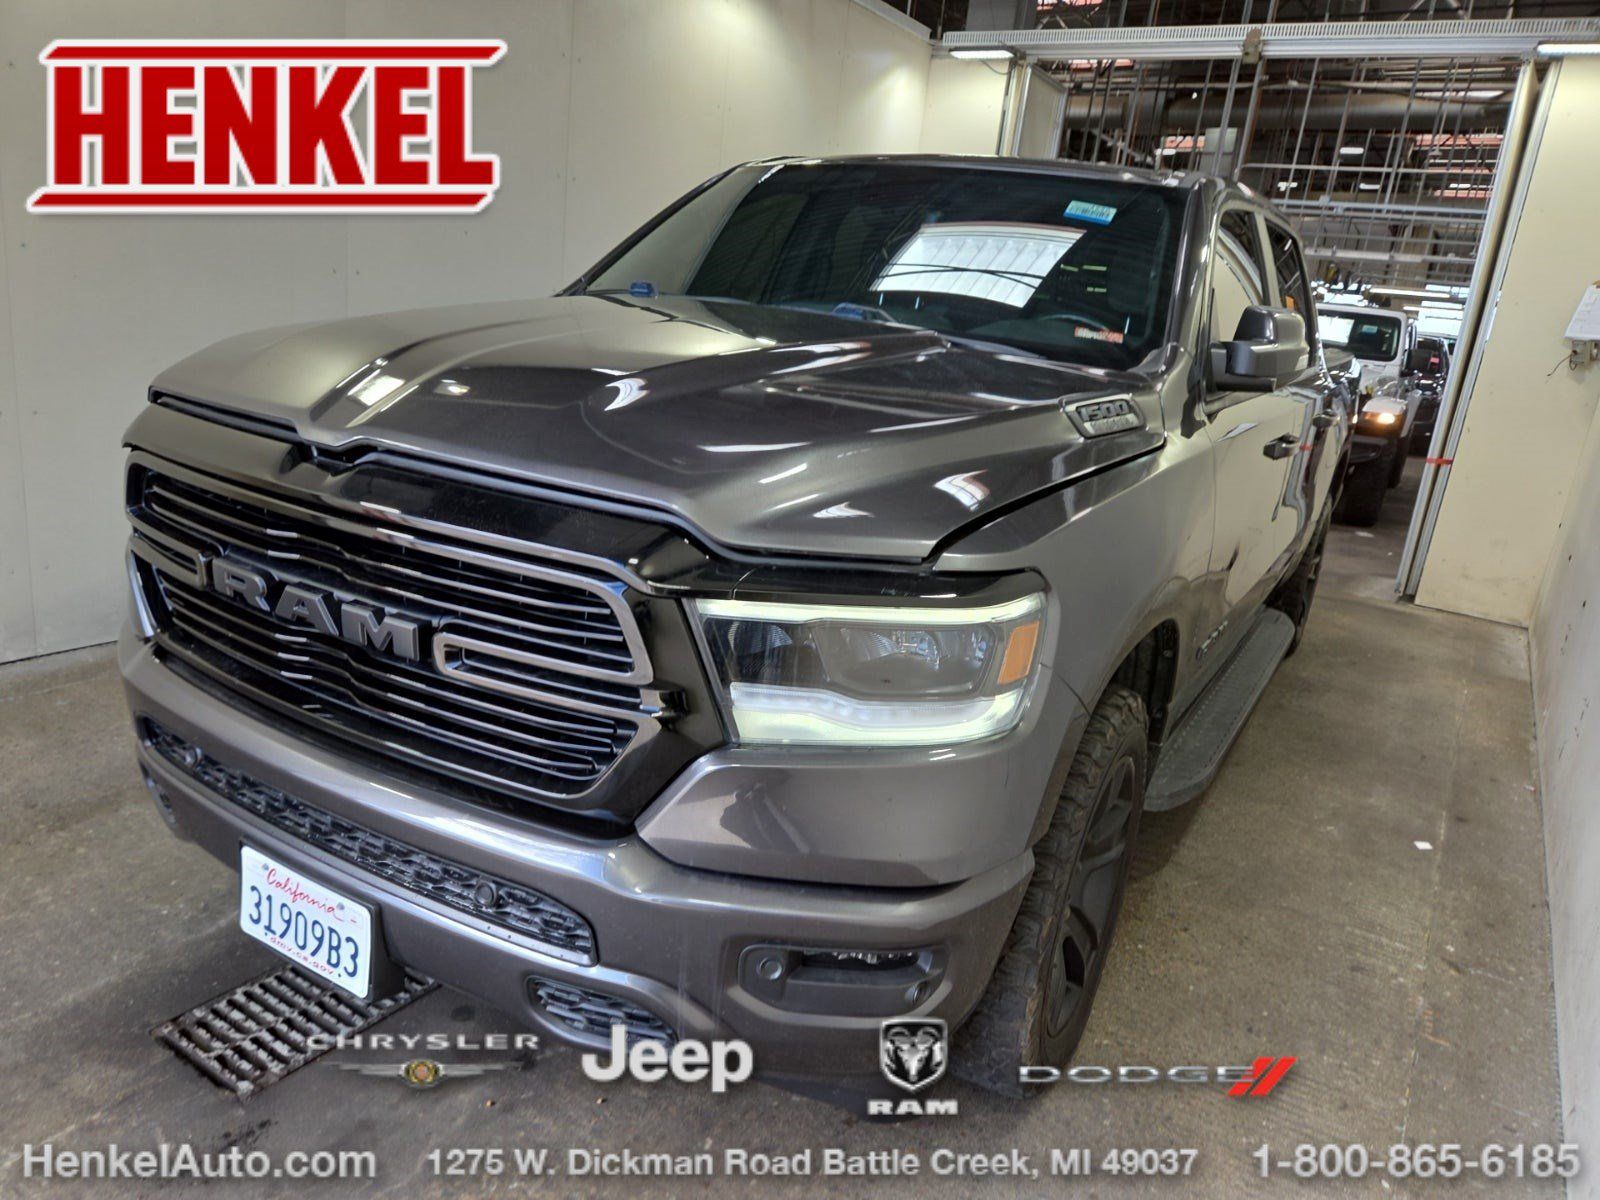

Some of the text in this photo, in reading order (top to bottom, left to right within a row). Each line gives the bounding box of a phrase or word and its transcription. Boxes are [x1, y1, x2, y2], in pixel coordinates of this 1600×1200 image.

[1080, 400, 1129, 422] 1500
[212, 556, 420, 662] RAM
[249, 885, 359, 978] 31909B3
[266, 868, 344, 922] California
